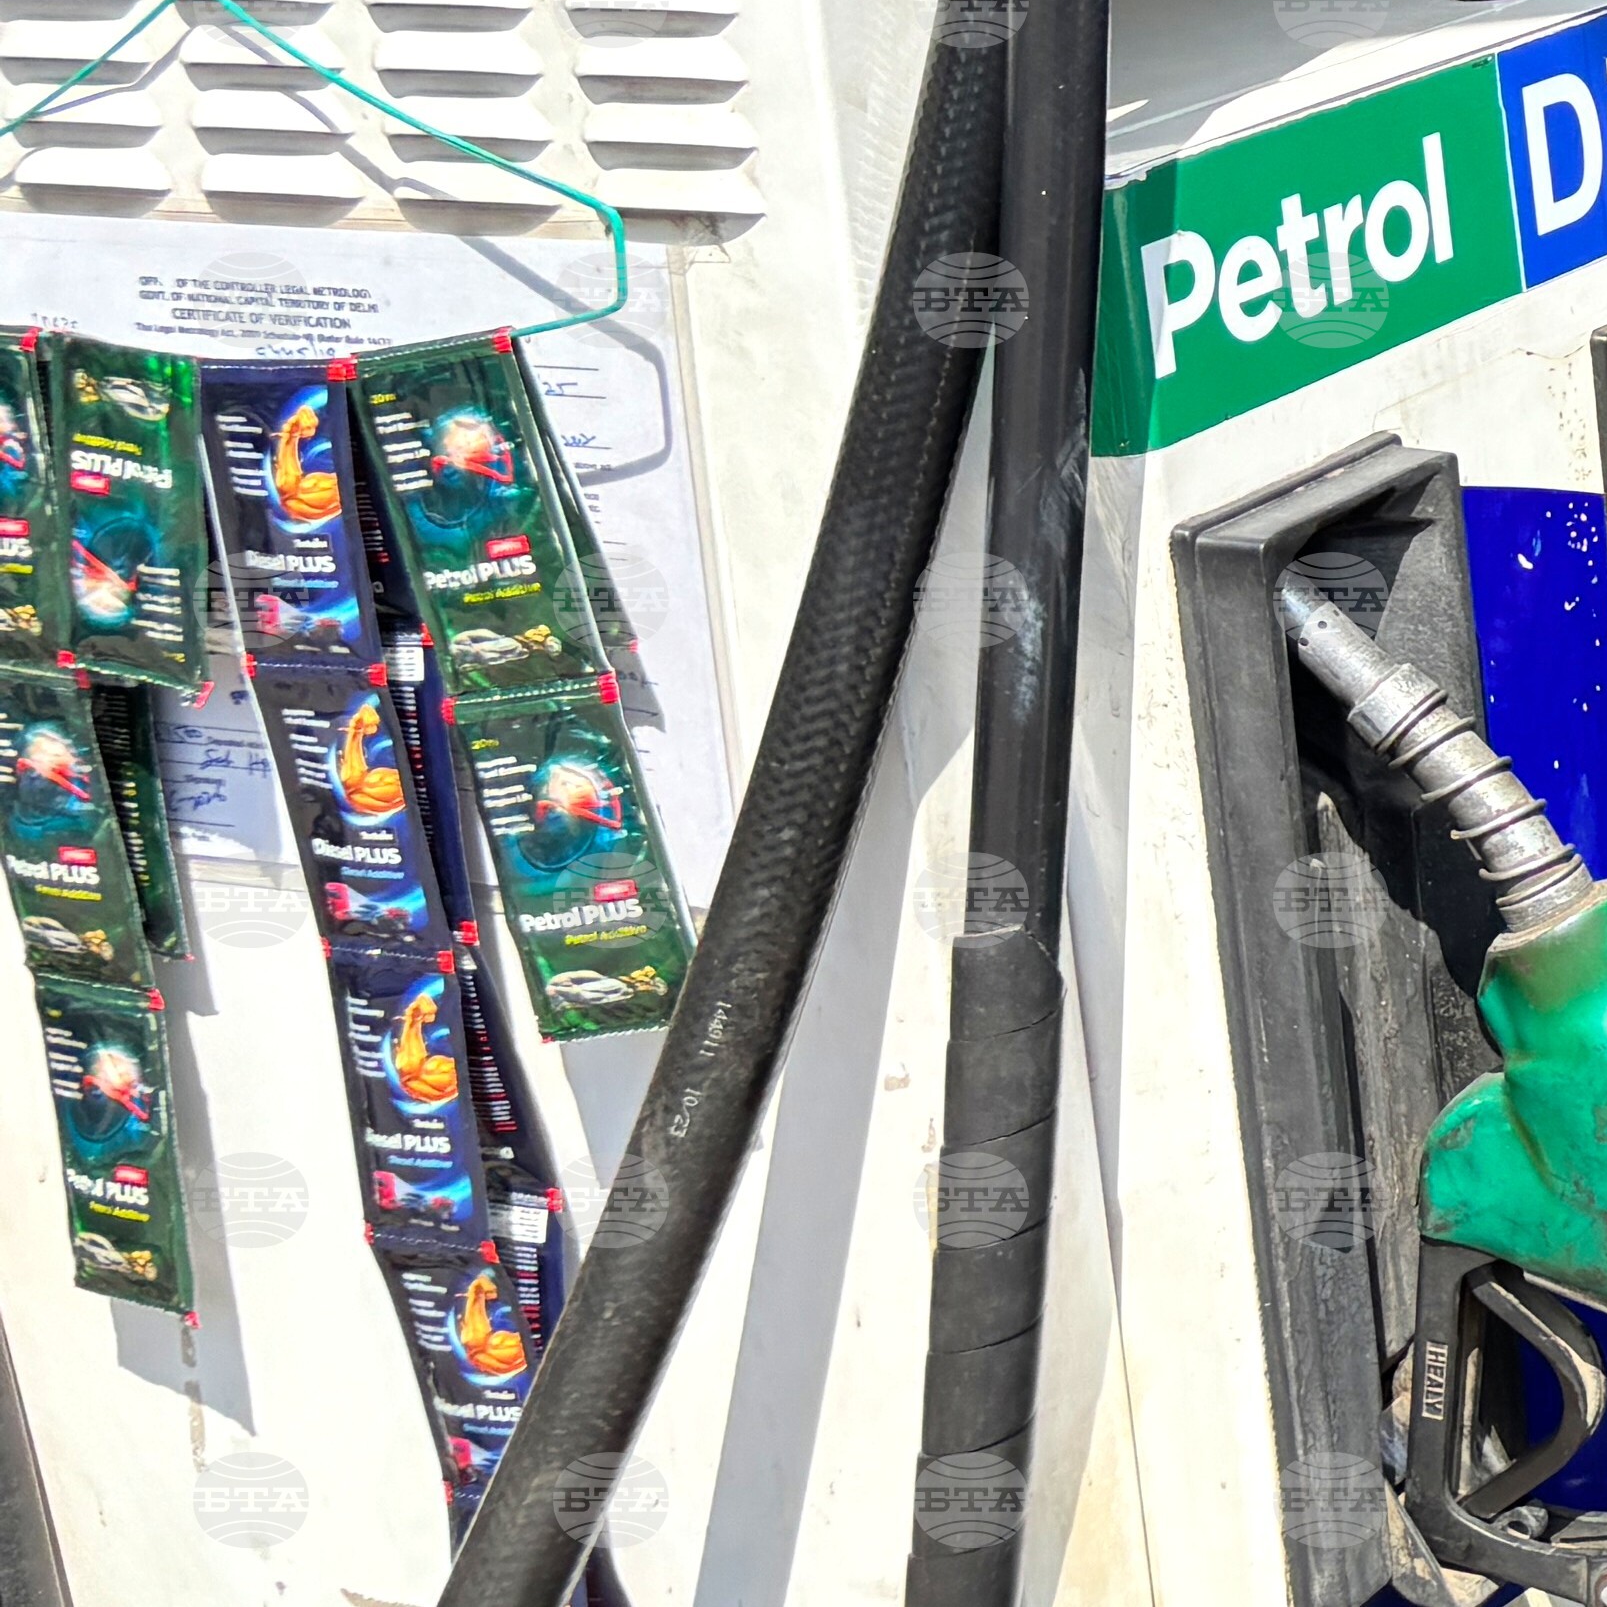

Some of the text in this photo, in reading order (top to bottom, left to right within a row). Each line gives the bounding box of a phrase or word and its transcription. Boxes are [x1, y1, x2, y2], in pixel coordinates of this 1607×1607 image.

[1141, 132, 1453, 379] Petrol
[171, 308, 351, 329] CERTIFICATE OF VERIFICATION
[286, 554, 337, 573] PLUS
[480, 555, 538, 580] PLUS
[352, 846, 402, 866] PLUS
[50, 863, 101, 884] PLUS
[520, 898, 644, 933] Petrol PLUS
[403, 1133, 451, 1154] PLUS
[1424, 1344, 1447, 1413] HEALY
